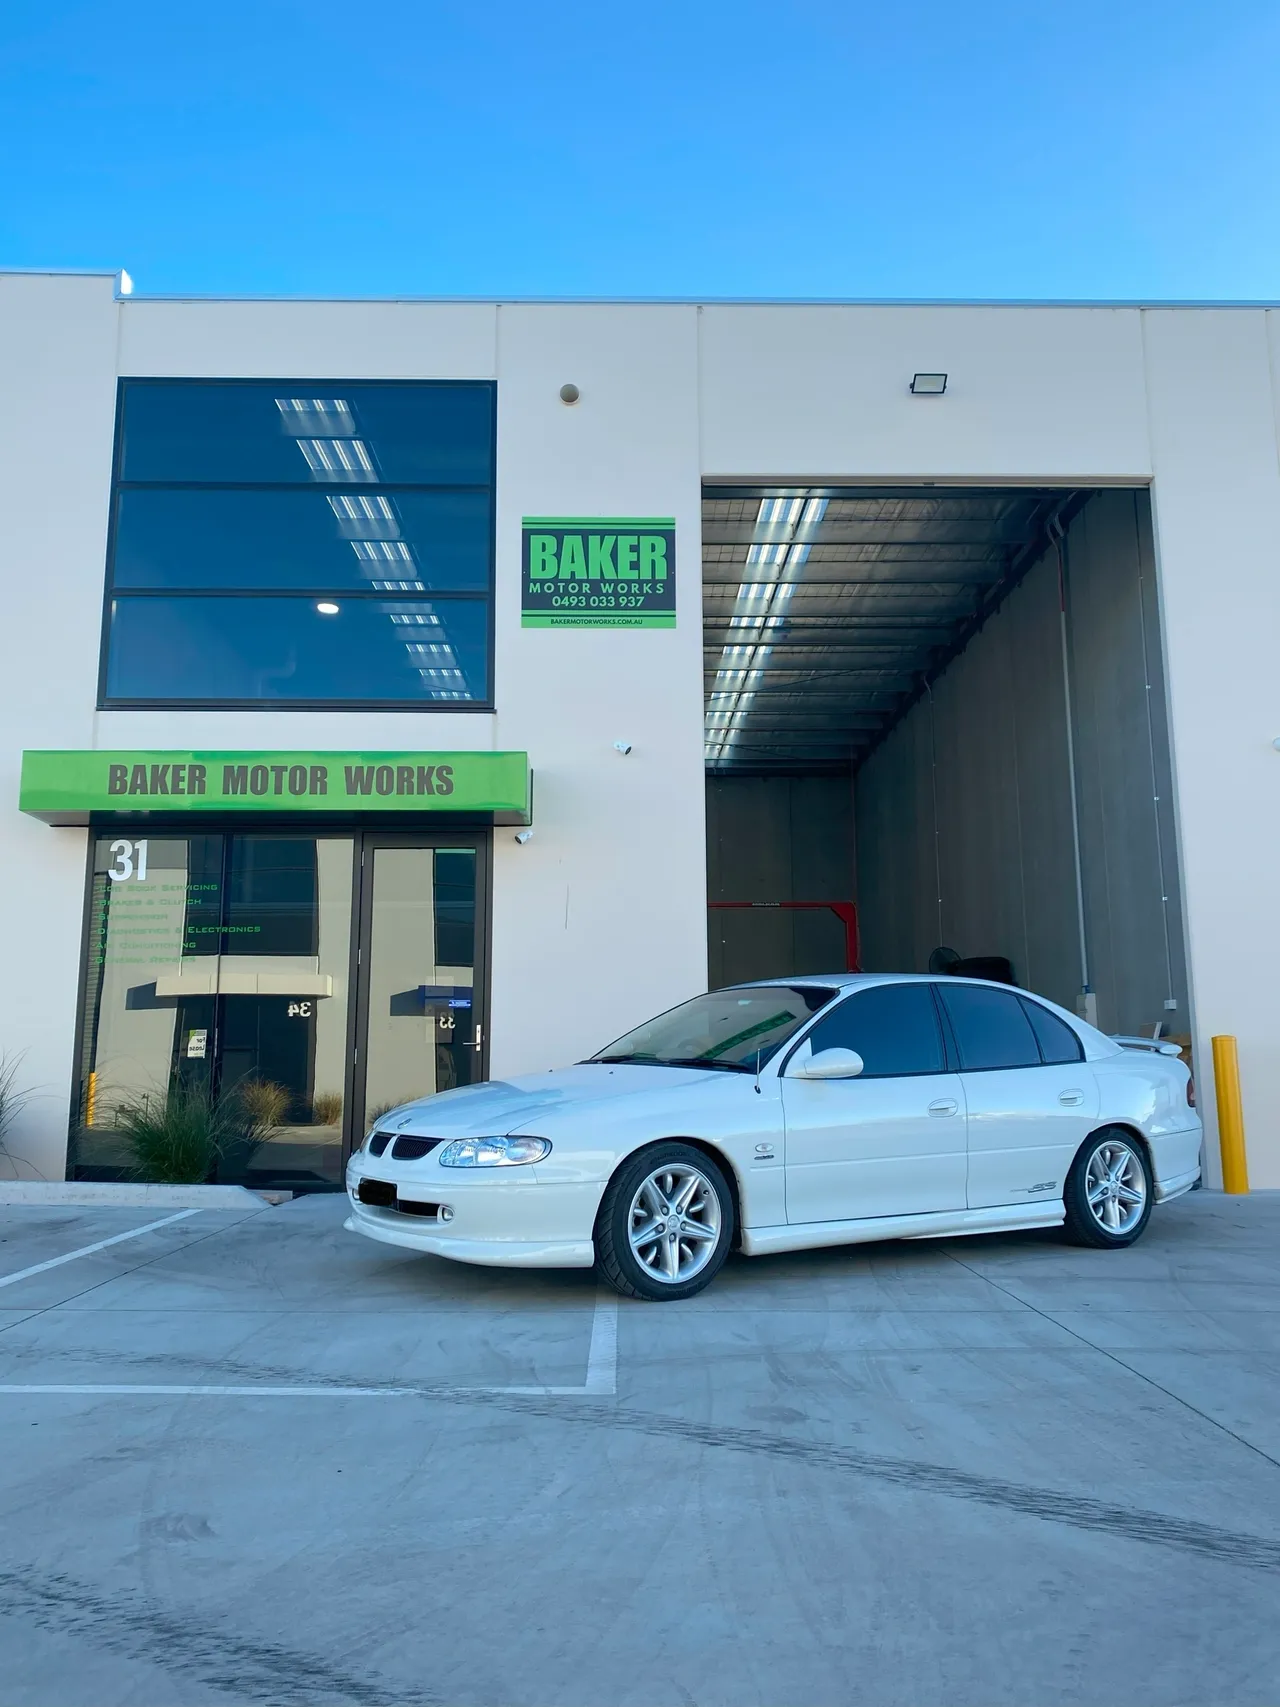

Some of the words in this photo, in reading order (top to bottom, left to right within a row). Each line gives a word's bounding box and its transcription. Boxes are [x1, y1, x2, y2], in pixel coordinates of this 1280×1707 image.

[530, 535, 667, 579] BAKER
[529, 583, 591, 594] MOTOR
[601, 583, 664, 594] WORKS
[552, 596, 586, 607] 0493
[590, 596, 615, 607] 033
[619, 596, 645, 607] 937
[108, 764, 207, 795] BAKER
[222, 765, 328, 795] MOTOR
[344, 765, 454, 796] WORKS
[108, 839, 148, 881] 31
